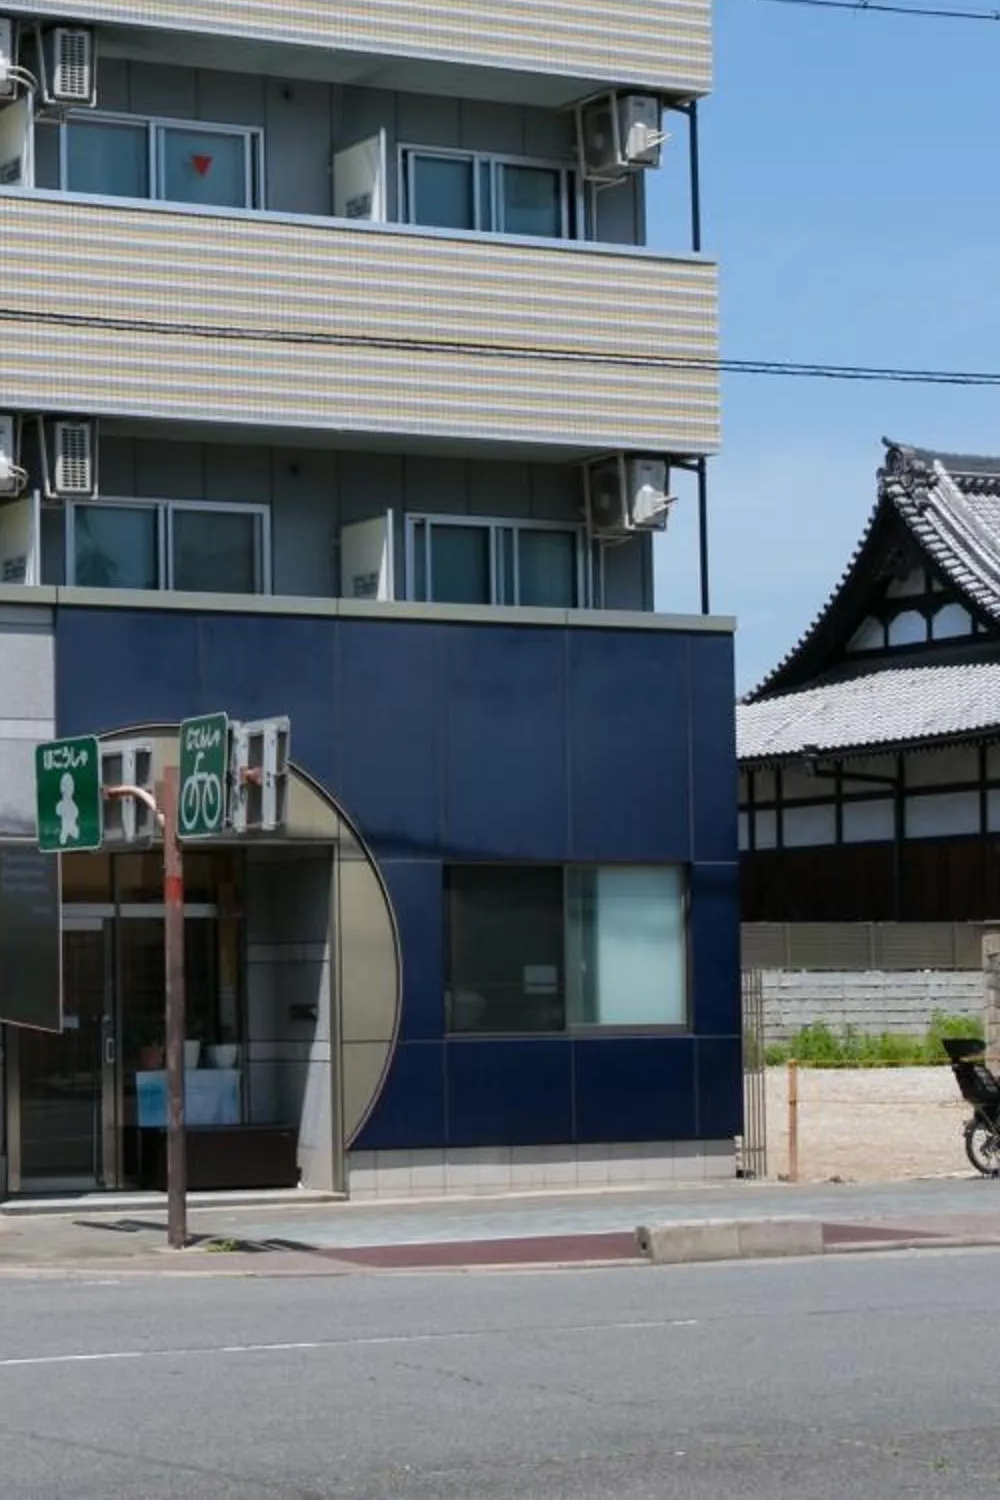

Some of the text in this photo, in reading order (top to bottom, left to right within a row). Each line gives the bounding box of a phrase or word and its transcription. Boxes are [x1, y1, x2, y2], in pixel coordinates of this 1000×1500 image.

[43, 745, 89, 771] はこうしゃ
